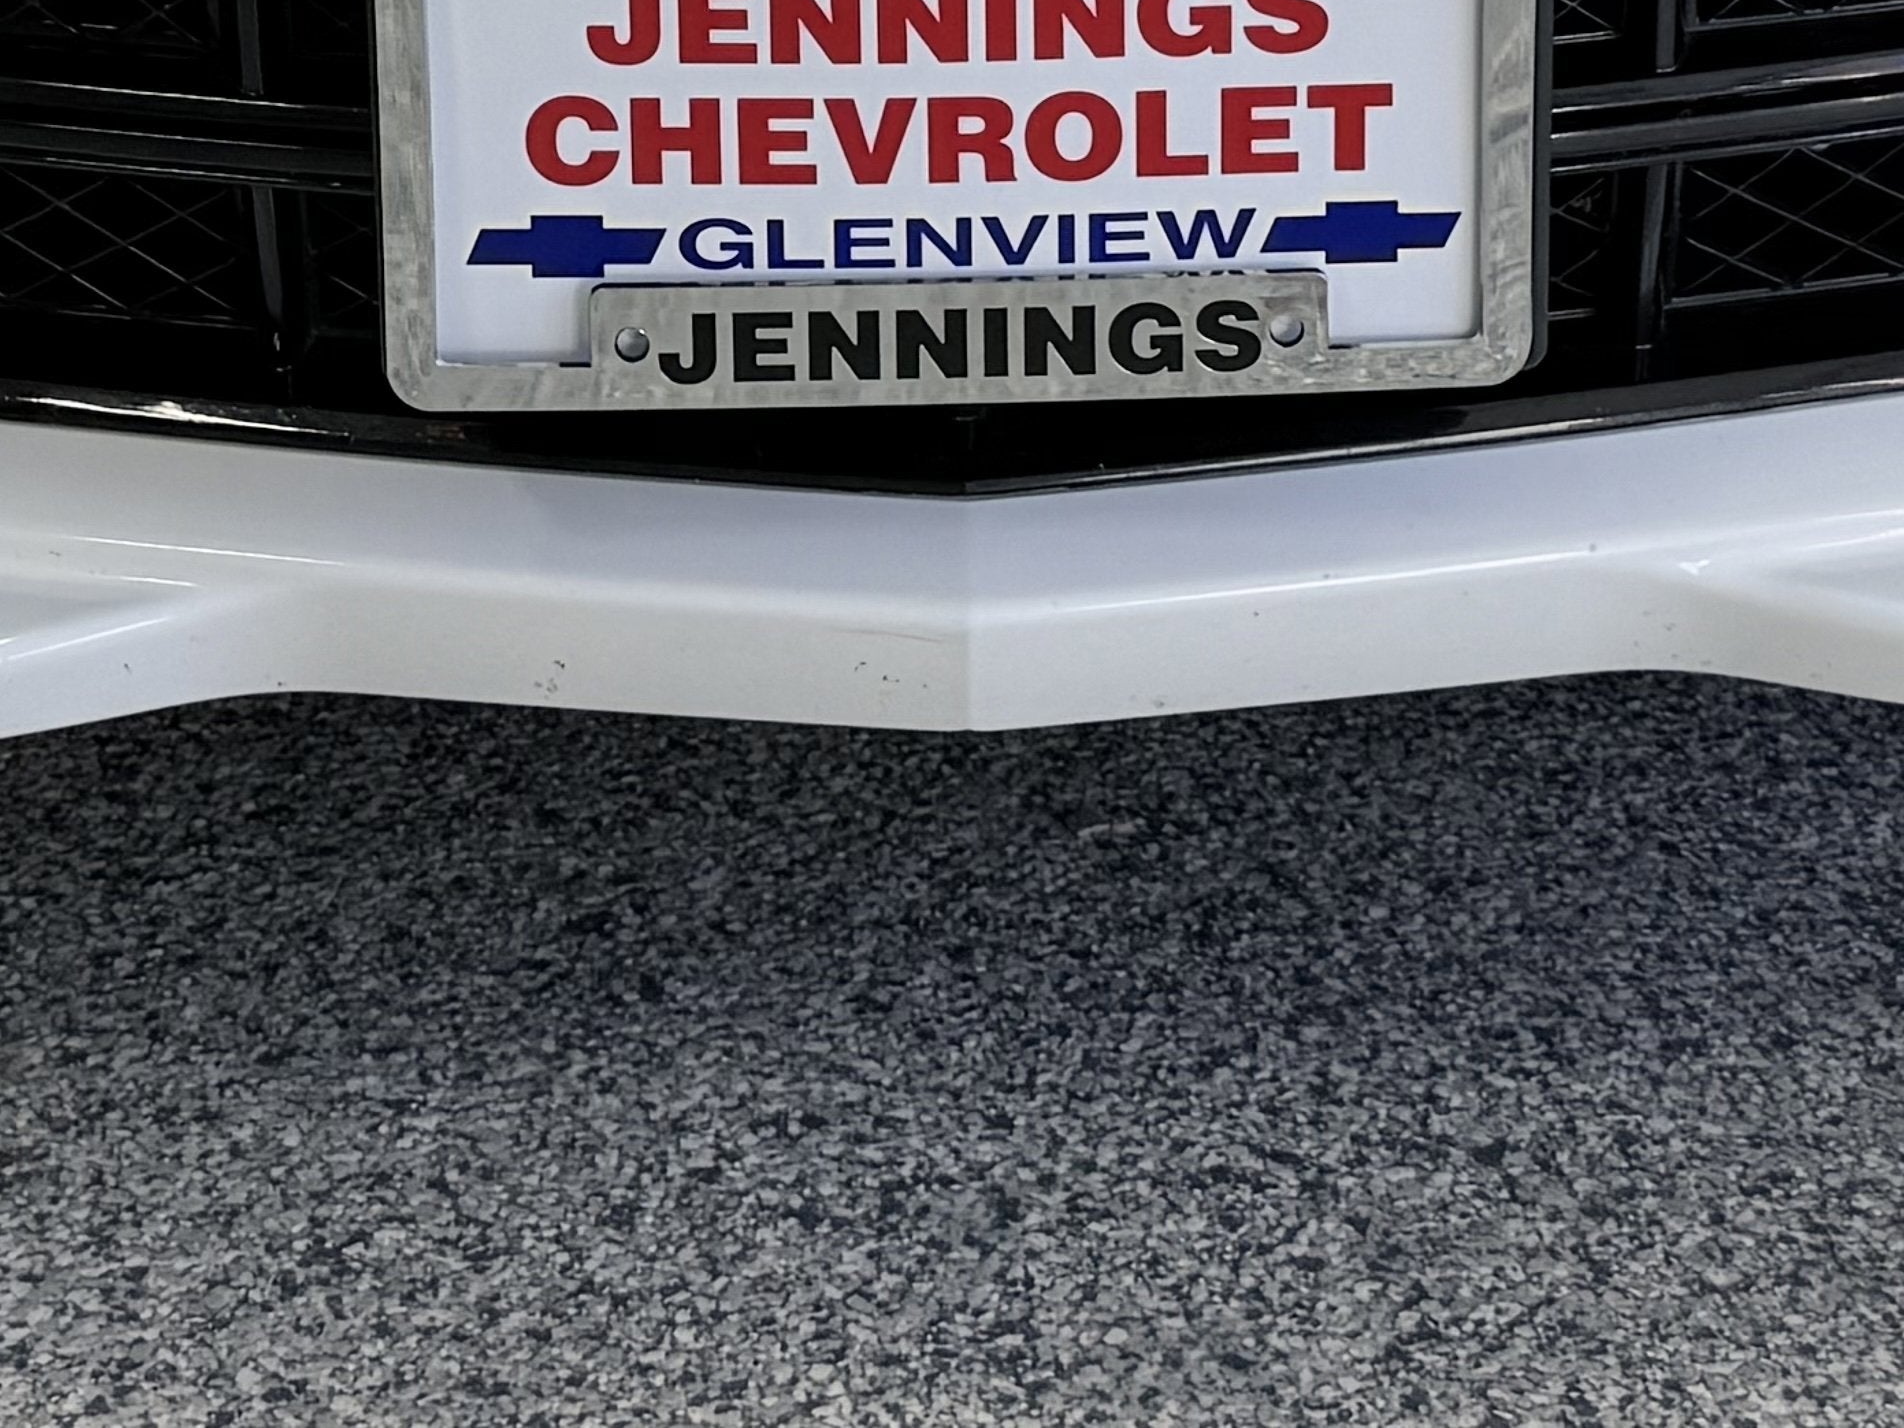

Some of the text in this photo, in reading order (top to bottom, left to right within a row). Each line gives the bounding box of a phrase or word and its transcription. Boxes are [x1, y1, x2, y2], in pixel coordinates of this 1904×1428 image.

[525, 83, 1393, 187] CHEVROLET
[677, 208, 1257, 272] GLENVIEW
[656, 298, 1264, 386] JENNINGS
